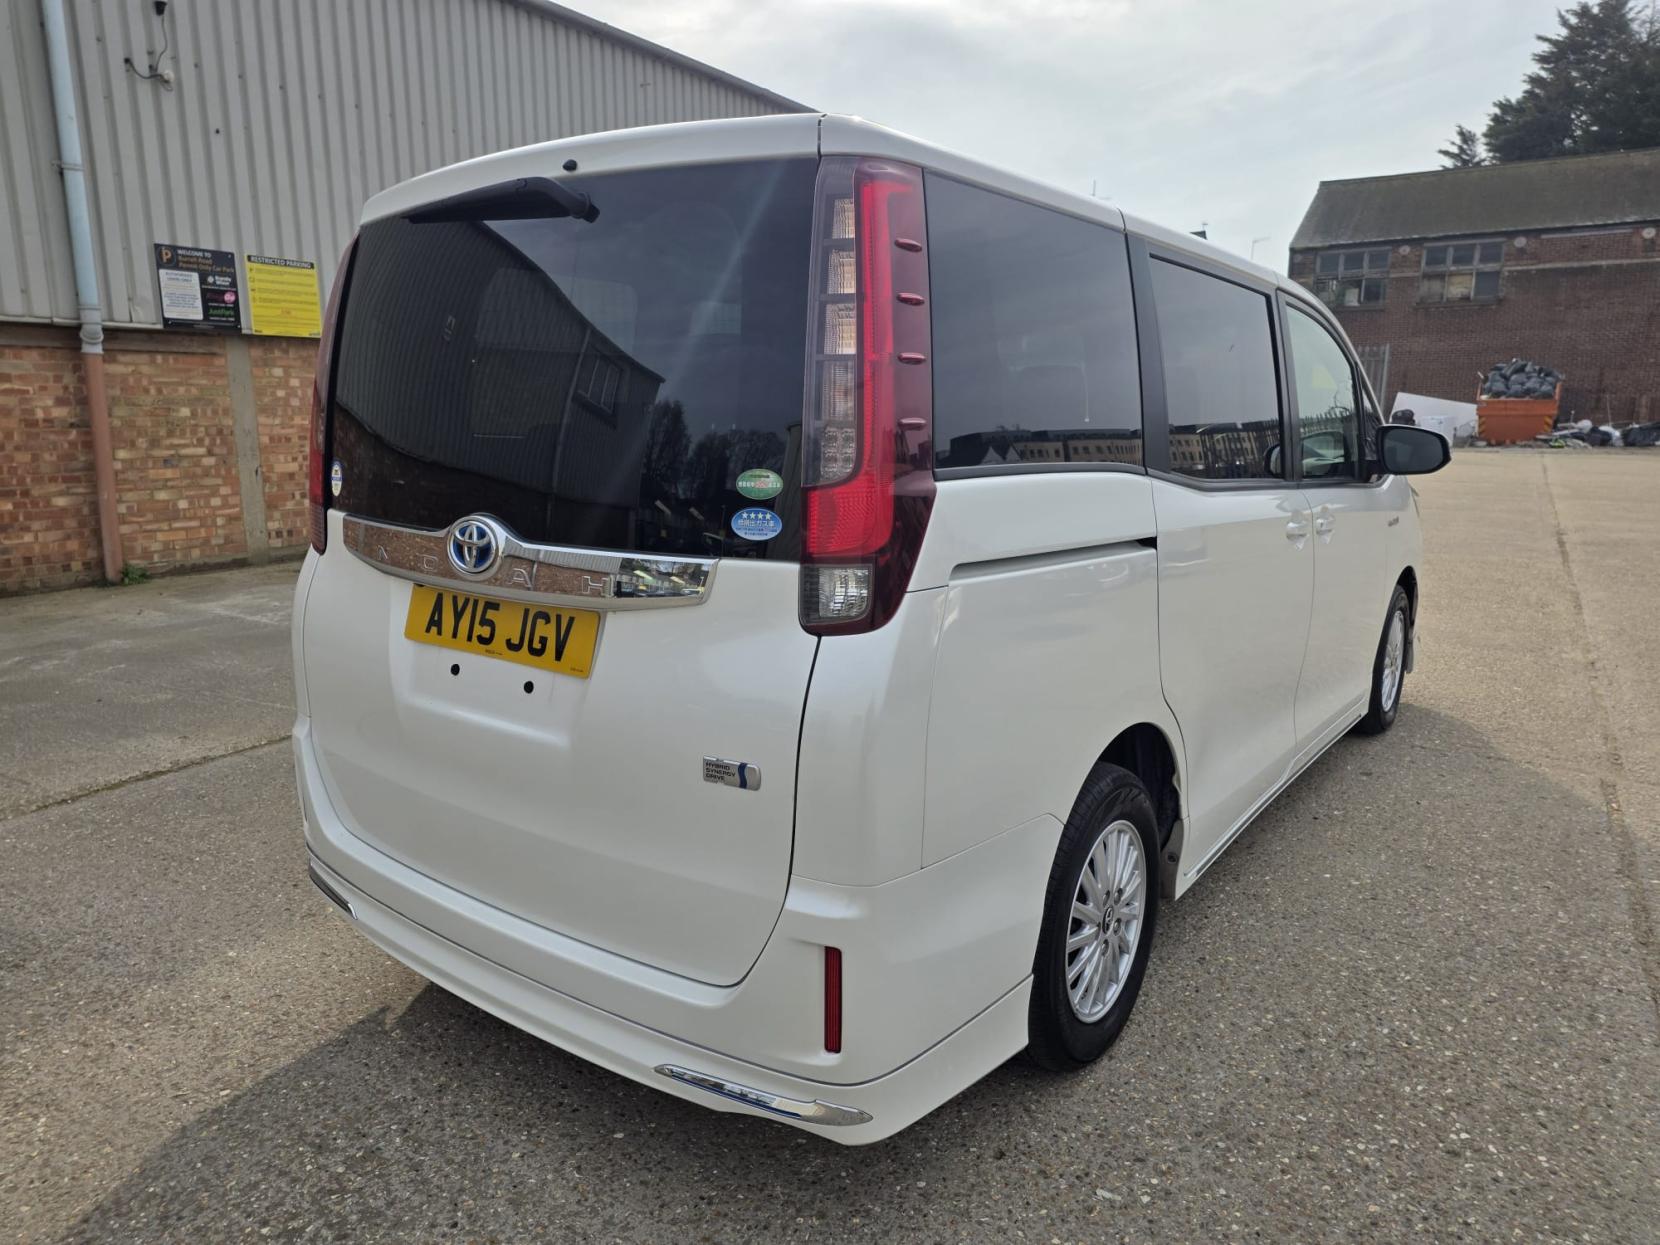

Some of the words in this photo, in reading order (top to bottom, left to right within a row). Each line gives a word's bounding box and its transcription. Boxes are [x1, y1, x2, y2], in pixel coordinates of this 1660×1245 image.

[177, 249, 203, 257] WELCOME
[250, 256, 286, 266] RESTRICTED
[286, 260, 311, 268] PARKING
[425, 592, 500, 646] AY15
[505, 608, 575, 662] JGV
[705, 762, 731, 771] HYBRID
[705, 767, 736, 777] SYNERGY
